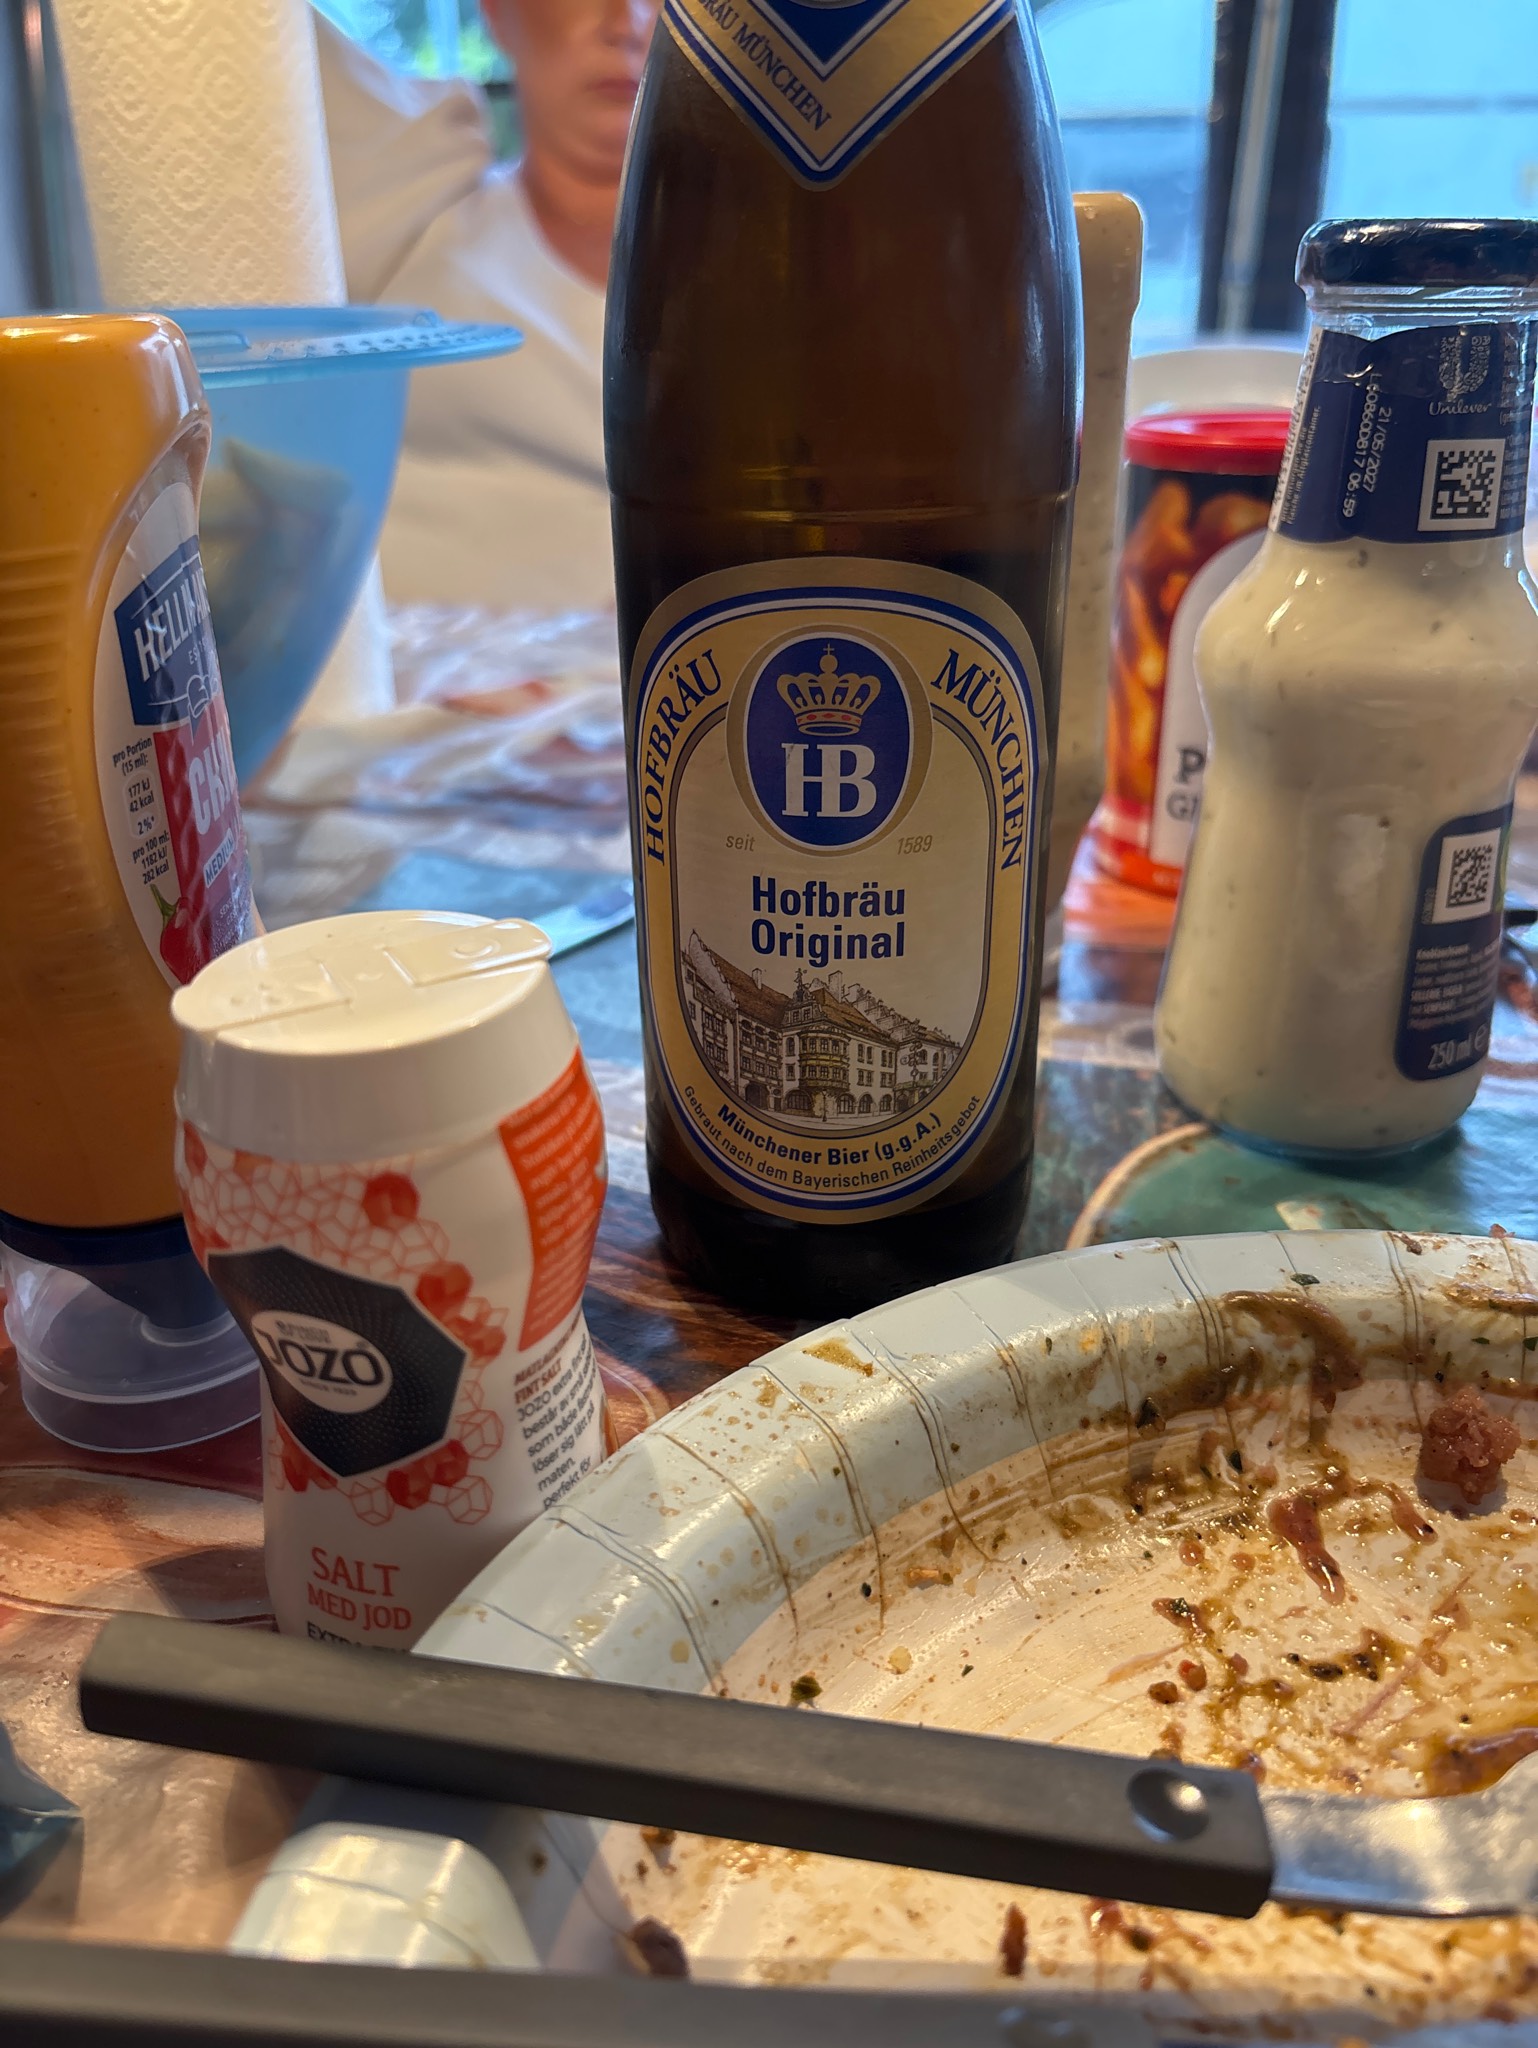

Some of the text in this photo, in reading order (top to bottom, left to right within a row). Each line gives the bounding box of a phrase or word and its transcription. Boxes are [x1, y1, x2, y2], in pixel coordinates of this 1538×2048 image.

[700, 0, 832, 131] RÄU MÜNCHEN
[1429, 399, 1492, 416] Unilever
[1363, 407, 1392, 493] 21/05/2027
[1343, 472, 1361, 518] 06:59
[113, 737, 152, 767] pro Portion
[122, 753, 149, 776] (15 ml):
[647, 649, 1025, 869] HOFBRÄU MÜNCHEN
[128, 778, 150, 798] 177 kJ
[781, 742, 877, 818] HB
[129, 791, 154, 813] 42 kcal
[132, 830, 170, 864] pro 100 ml:
[137, 822, 143, 835] 2
[725, 834, 933, 854] seit 1589
[141, 854, 158, 869] 1182
[142, 859, 169, 885] 282 kcal
[752, 875, 906, 918] Hofbräu
[751, 918, 906, 968] Original
[1428, 1039, 1455, 1071] 250
[684, 1086, 980, 1190] Gebraut nach dem Bayerischen Reinheitsgebot
[717, 1104, 942, 1165] Münchener Bier (g.g.A.)
[255, 1327, 384, 1386] JOZO
[517, 1390, 551, 1422] JOZO
[523, 1407, 557, 1439] består
[528, 1433, 555, 1457] som
[532, 1447, 559, 1474] löser
[561, 1434, 575, 1453] sig
[543, 1456, 591, 1511] perfekt för
[312, 1546, 400, 1596] SALT
[307, 1581, 412, 1631] MED JOD
